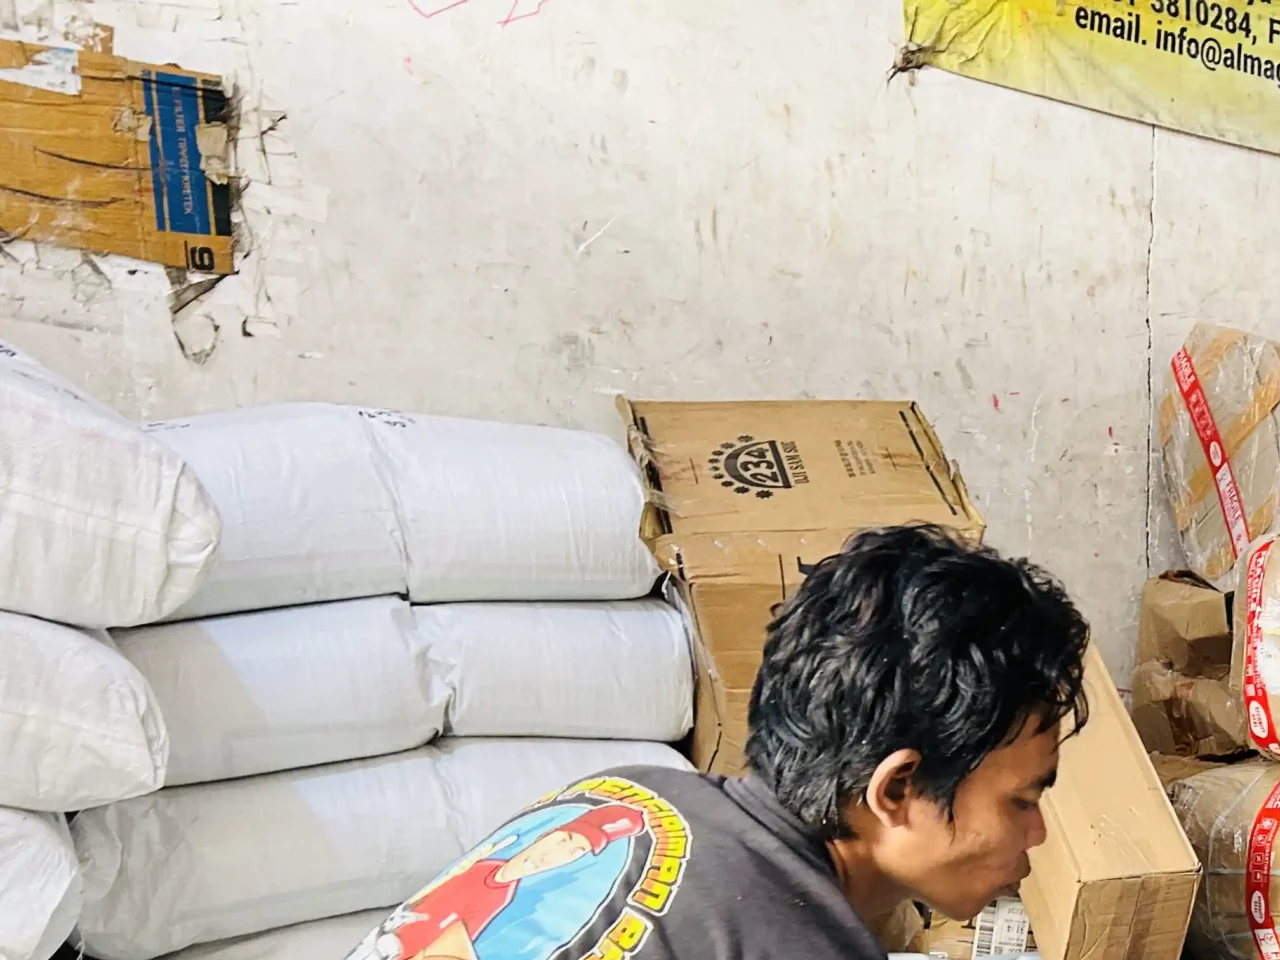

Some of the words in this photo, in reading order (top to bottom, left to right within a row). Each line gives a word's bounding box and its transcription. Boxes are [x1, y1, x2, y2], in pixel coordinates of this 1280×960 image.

[1075, 6, 1147, 46] email.
[739, 447, 781, 485] 234
[1225, 481, 1243, 523] FRAGILE
